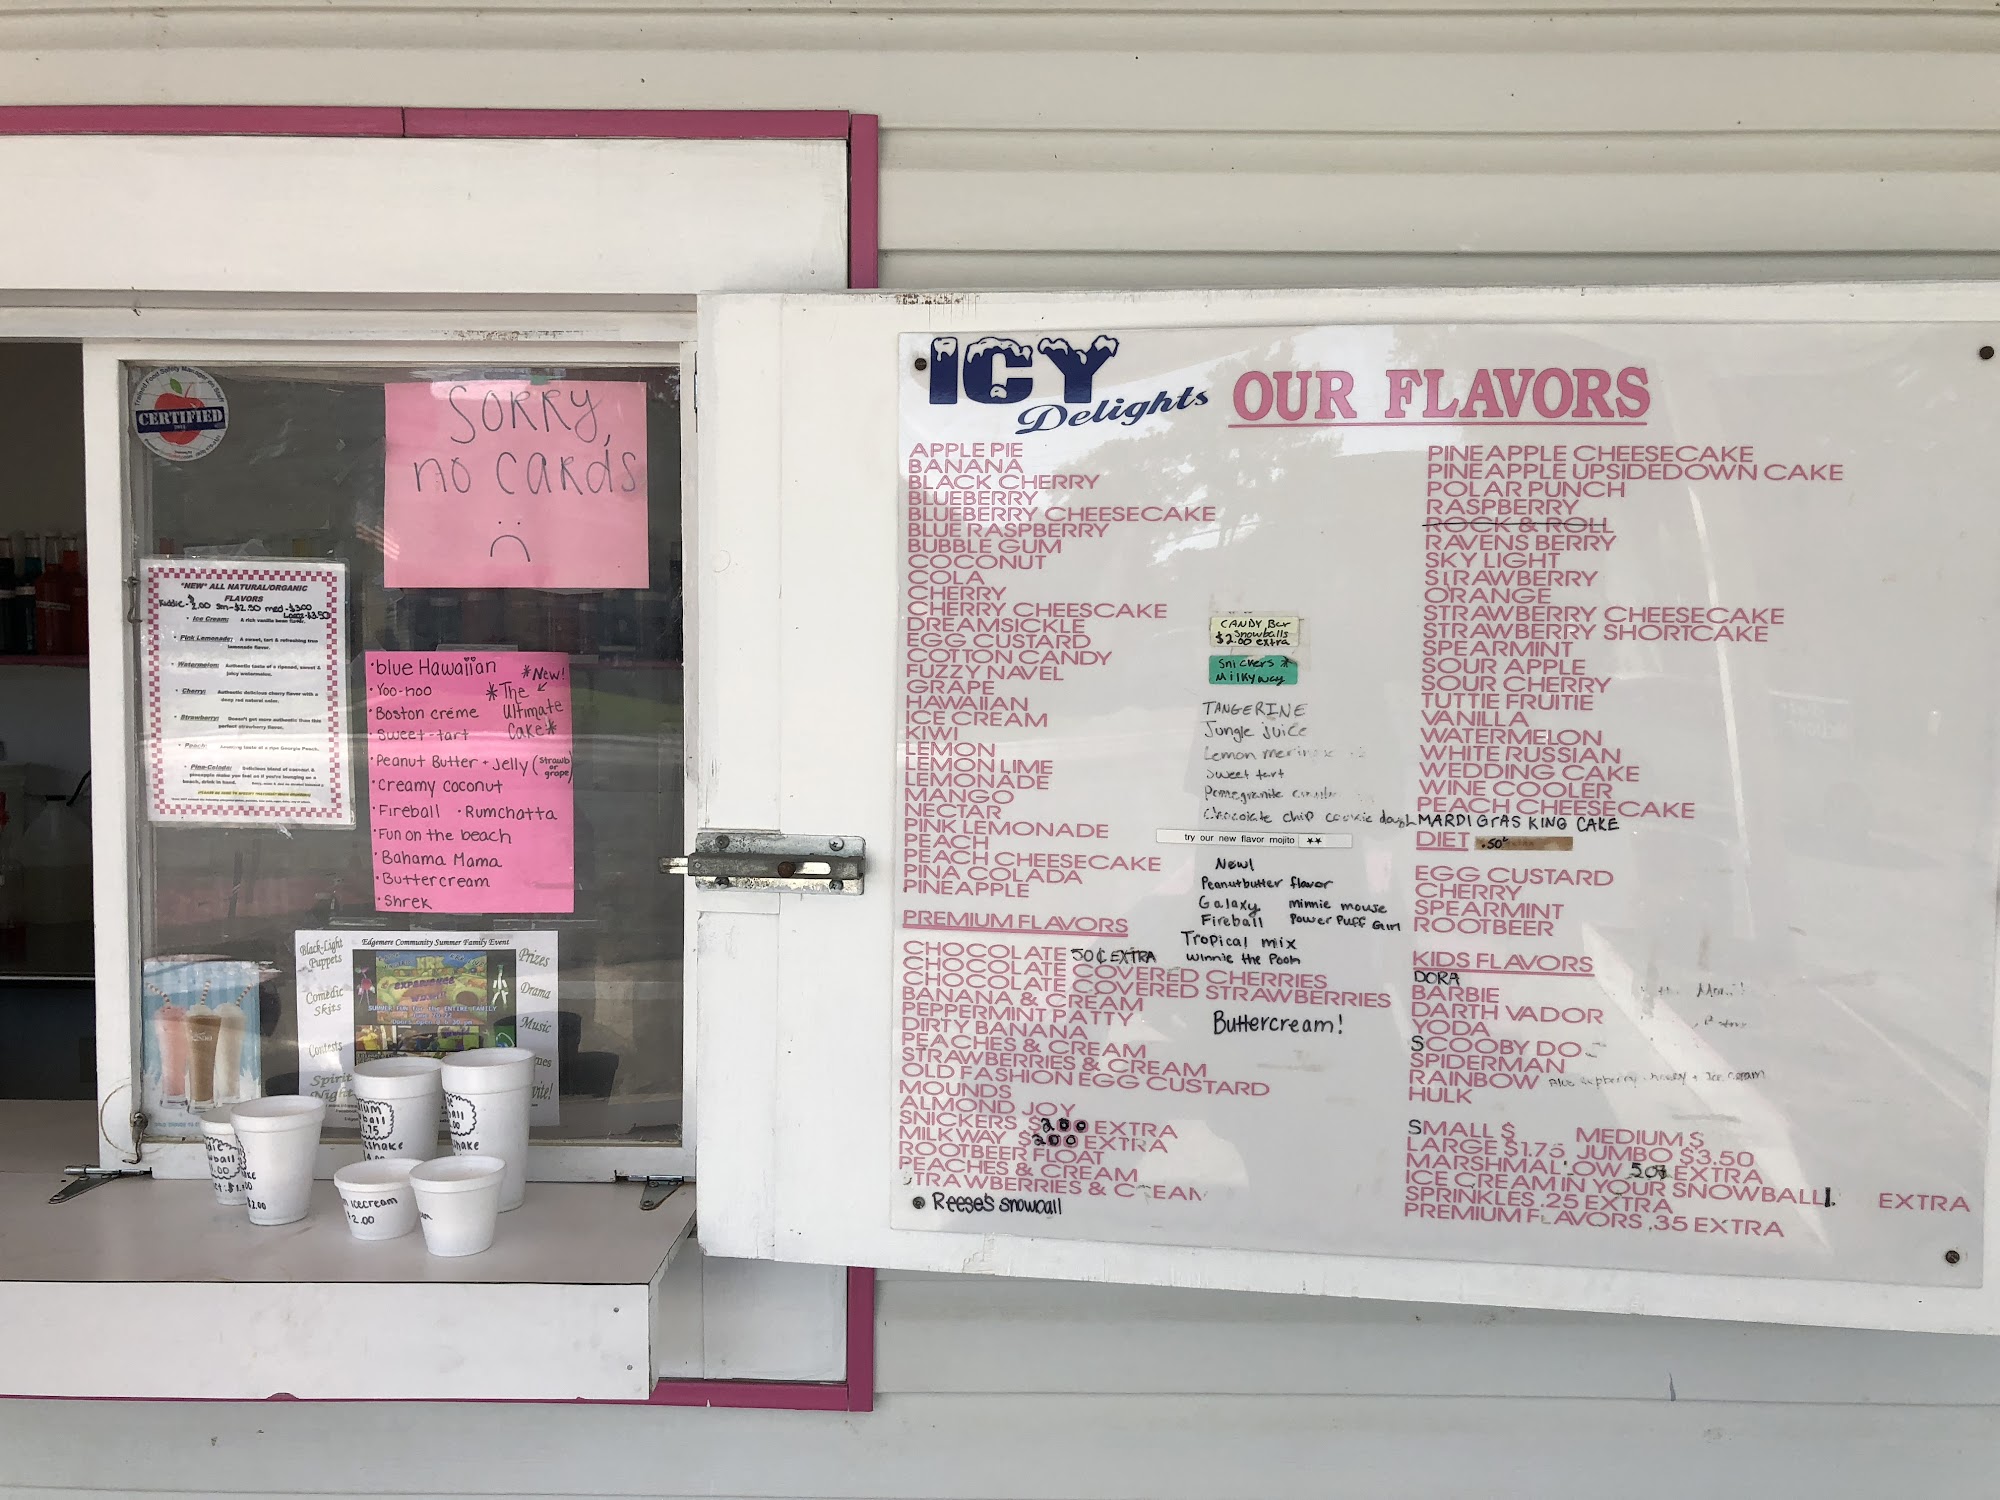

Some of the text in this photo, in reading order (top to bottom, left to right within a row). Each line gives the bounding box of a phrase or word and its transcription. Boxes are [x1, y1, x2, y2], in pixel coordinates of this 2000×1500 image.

[929, 335, 1120, 404] ICY
[1233, 367, 1651, 421] OUR FLAVORS
[138, 409, 223, 426] CERTIFIED
[1015, 386, 1209, 434] Delights
[909, 443, 1024, 458] APPLE PIE
[1428, 445, 1754, 462] PINEAPPLE CHEESECAKE
[908, 458, 1024, 474] BANANA
[1428, 463, 1843, 481] PINEAPPLE UPSIDEDOWN CAKE
[414, 456, 472, 494] no
[908, 475, 1100, 490] BLACK CHERRY
[1427, 481, 1625, 498] POLAR PUNCH
[908, 491, 1038, 506] BLUEBERRY
[1426, 499, 1579, 516] RASPBERRY
[908, 554, 1046, 570] COCONUT
[908, 570, 985, 586] COLA
[227, 583, 309, 592] NATURAL/ORGANIC
[907, 586, 1007, 601] CHERRY
[1424, 587, 1551, 605] ORANGE
[907, 601, 1168, 619] CHERRY CHEESCAKE
[907, 617, 1085, 634] DREAMSICKLE
[1220, 619, 1262, 628] CANDY
[1215, 631, 1290, 647] $2.00 extra
[376, 656, 497, 678] blue Hawaiian
[1218, 658, 1275, 669] Snickers
[181, 688, 207, 696] Cherry:
[906, 679, 995, 695] GRAPE
[180, 714, 220, 722] Strawberry:
[376, 706, 425, 721] Boston
[502, 699, 564, 721] Ultimate
[1202, 701, 1309, 719] TANGERINE
[1420, 710, 1529, 727] VANILLA
[905, 726, 958, 741] KIWI
[1201, 720, 1308, 743] Jungle juice
[1420, 727, 1602, 746] WATERMELON
[376, 754, 529, 777] Peanut Butter Jelly
[1419, 762, 1640, 783] WEDDING CAKE
[443, 780, 503, 794] coconut
[905, 787, 1015, 804] MANGO
[1418, 779, 1613, 800] WINE COOLER
[379, 804, 557, 821] Fireball Rumchatta
[1529, 816, 1568, 830] KING
[1576, 816, 1620, 832] CAKE
[378, 828, 512, 845] Fun on the beach
[1184, 833, 1195, 842] try
[1241, 833, 1265, 843] flavor
[1269, 835, 1296, 846] mojito
[1415, 831, 1471, 848] DIET
[382, 850, 503, 868] Bahama Mama
[382, 872, 491, 888] Buttercream
[1290, 876, 1334, 890] flavor
[1414, 865, 1614, 887] EGG CUSTARD
[384, 895, 433, 910] Shrek
[1198, 895, 1261, 917] Galaxy
[1341, 902, 1388, 914] mouse
[1414, 901, 1565, 920] SPEARMINT
[903, 910, 1128, 933] PREMIUM FLAVORS
[1201, 914, 1264, 929] Fireball
[1413, 917, 1554, 937] ROOTBEER
[299, 936, 344, 957] Black-Light
[361, 937, 510, 948] Edgemere Community Summer Family Event
[1181, 930, 1297, 950] Tropical mix
[308, 953, 343, 971] Puppets
[518, 947, 550, 968] Prizes
[1241, 953, 1301, 965] the Pooh
[1412, 951, 1594, 972] KIDS FLAVORS
[1413, 970, 1461, 987] DORA
[305, 986, 344, 1006] Comedic
[520, 981, 552, 1000] Drama
[1412, 984, 1500, 1003] BARBIE
[313, 1002, 342, 1018] Skits
[520, 1016, 552, 1034] Music
[1213, 1009, 1343, 1035] Buttercream!
[308, 1041, 344, 1059] Contests
[310, 1073, 352, 1090] Spirit
[899, 1080, 1012, 1098] MOUNDS
[310, 1083, 354, 1103] Night
[1408, 1086, 1473, 1104] HULK
[1577, 1147, 1755, 1168] JUMBO $3.50
[1877, 1191, 1971, 1212] EXTRA
